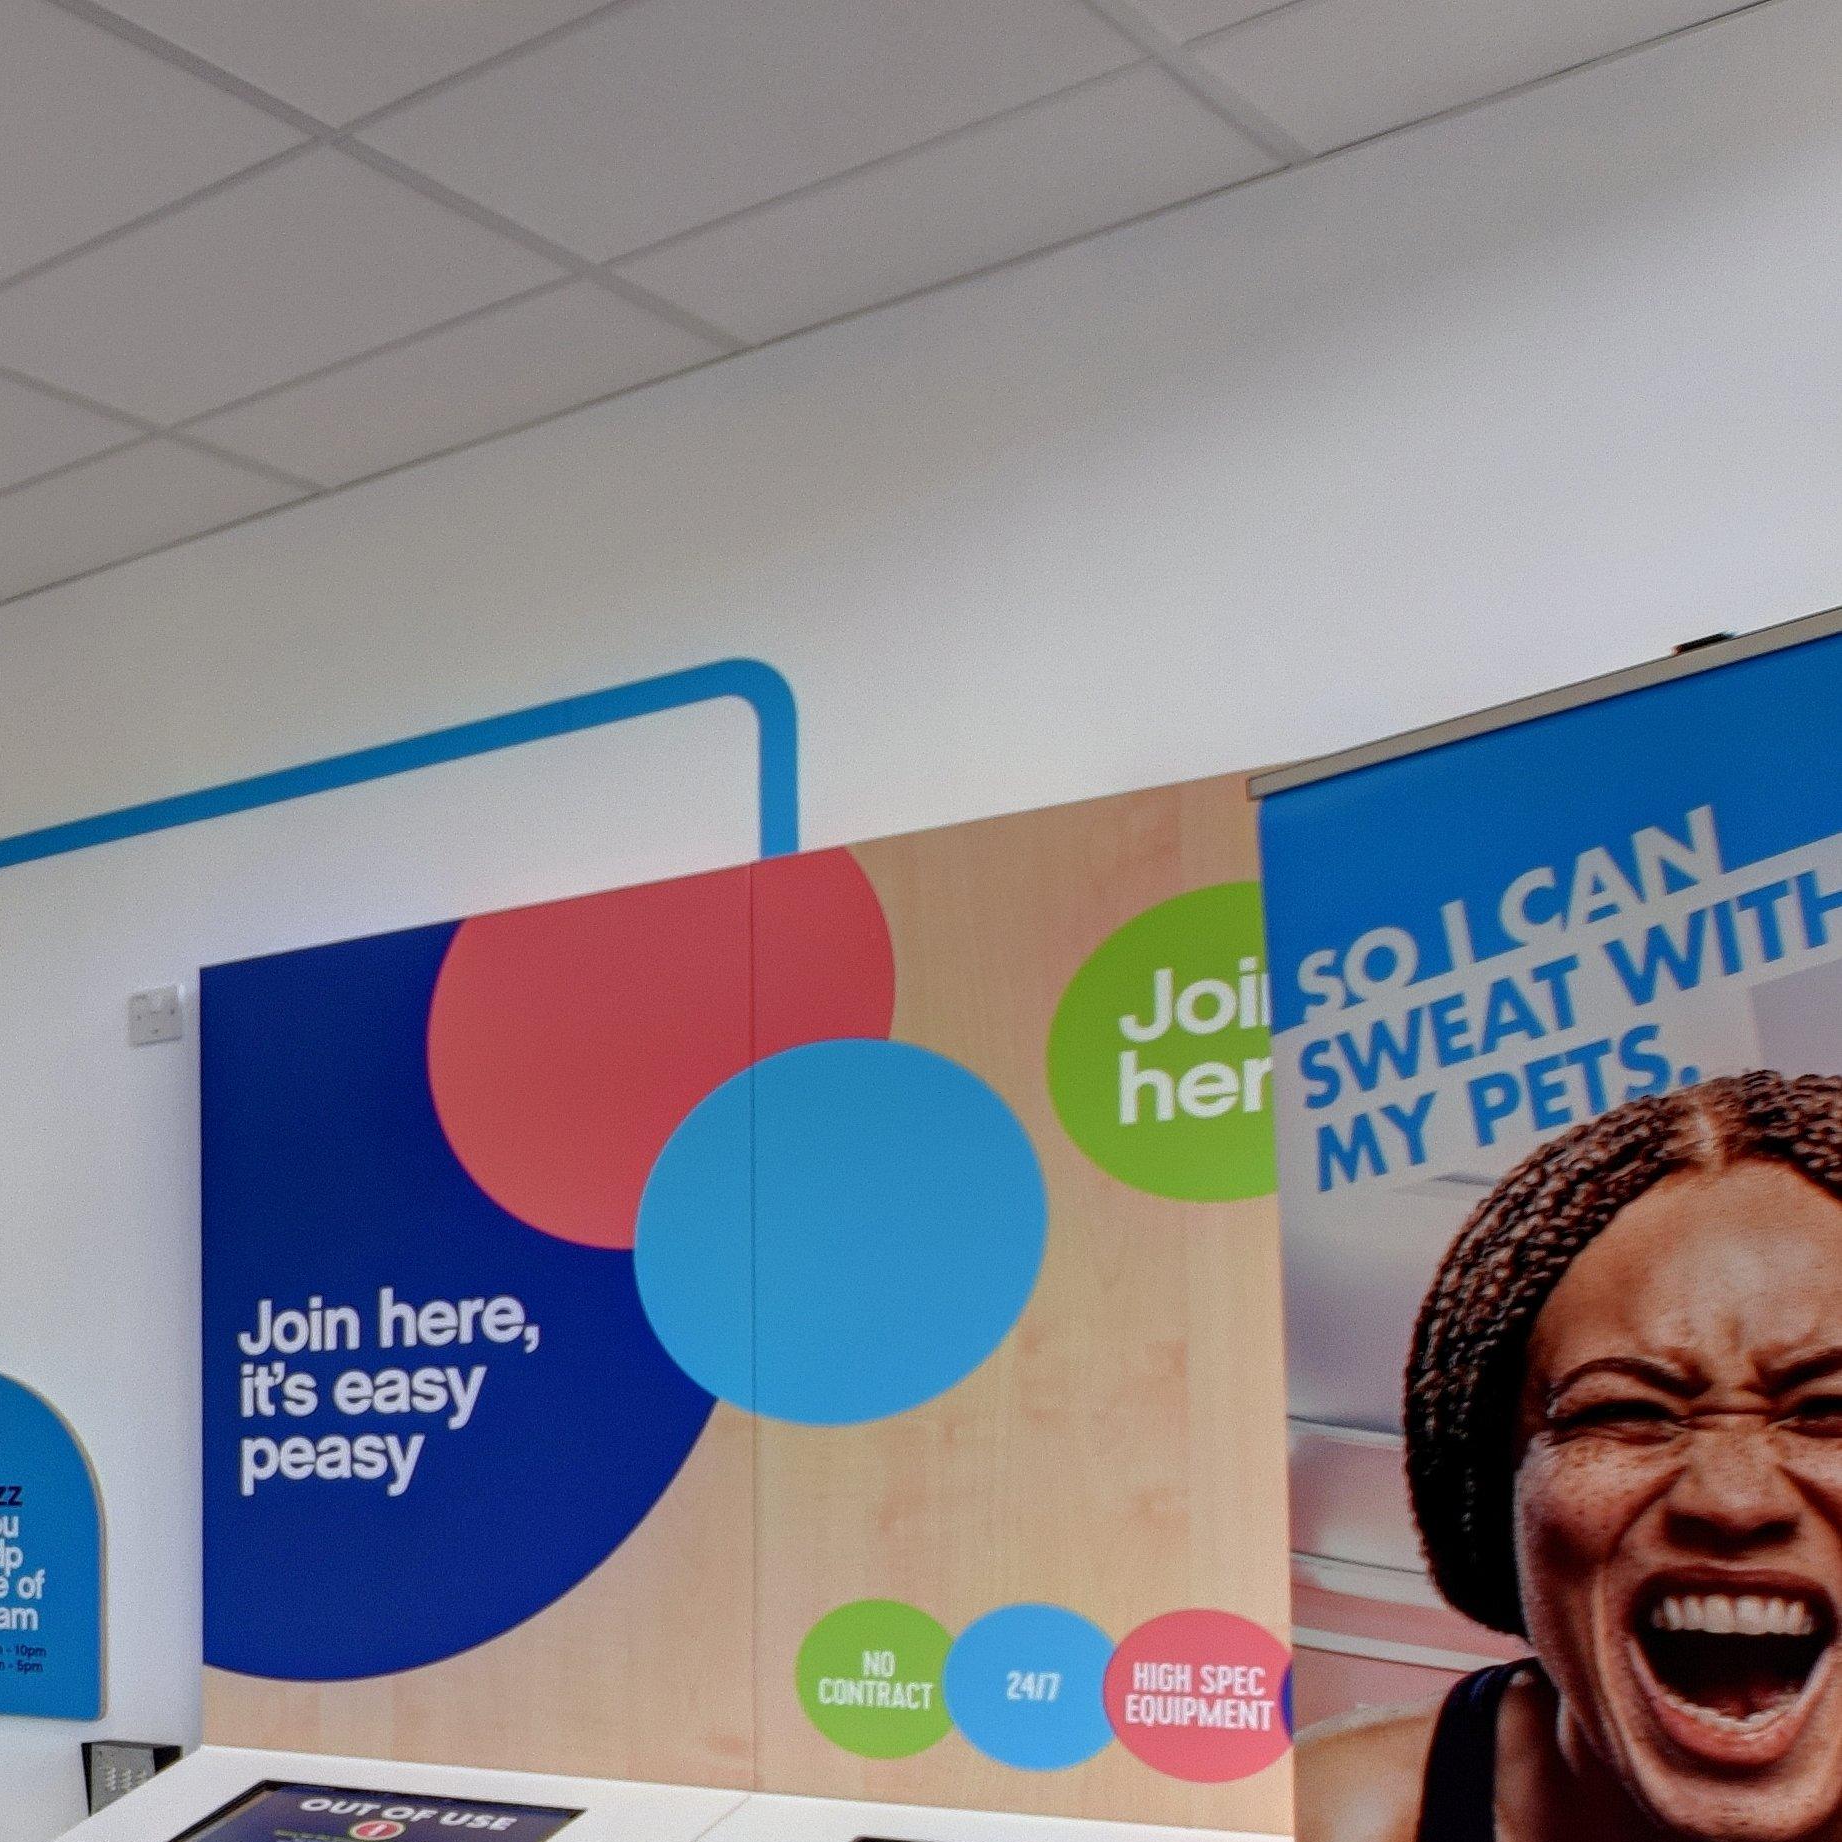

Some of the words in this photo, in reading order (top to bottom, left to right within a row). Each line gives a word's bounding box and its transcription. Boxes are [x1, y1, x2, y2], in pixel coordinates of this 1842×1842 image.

[1297, 925, 1417, 1023] SO
[1440, 900, 1474, 971] I
[1498, 804, 1722, 946] CAN
[1299, 955, 1579, 1109] SWEAT
[1118, 1050, 1273, 1125] her
[1316, 1091, 1436, 1192] MY
[1468, 1023, 1701, 1147] PETS.
[237, 1295, 361, 1357] Join
[378, 1285, 541, 1354] here,
[239, 1361, 318, 1418] it's
[333, 1363, 488, 1430] easy
[239, 1433, 425, 1497] peasy
[17, 1568, 46, 1600] of
[15, 1643, 47, 1658] 10pm
[862, 1649, 896, 1679] NO
[817, 1677, 934, 1712] CONTRACT
[1006, 1670, 1061, 1702] 24/7
[1133, 1661, 1193, 1695] HIGH
[1199, 1664, 1266, 1699] SPEC
[1124, 1693, 1275, 1733] EQUIPMENT
[300, 1798, 382, 1817] OUT
[382, 1806, 438, 1822] OF
[439, 1811, 517, 1831] USE
